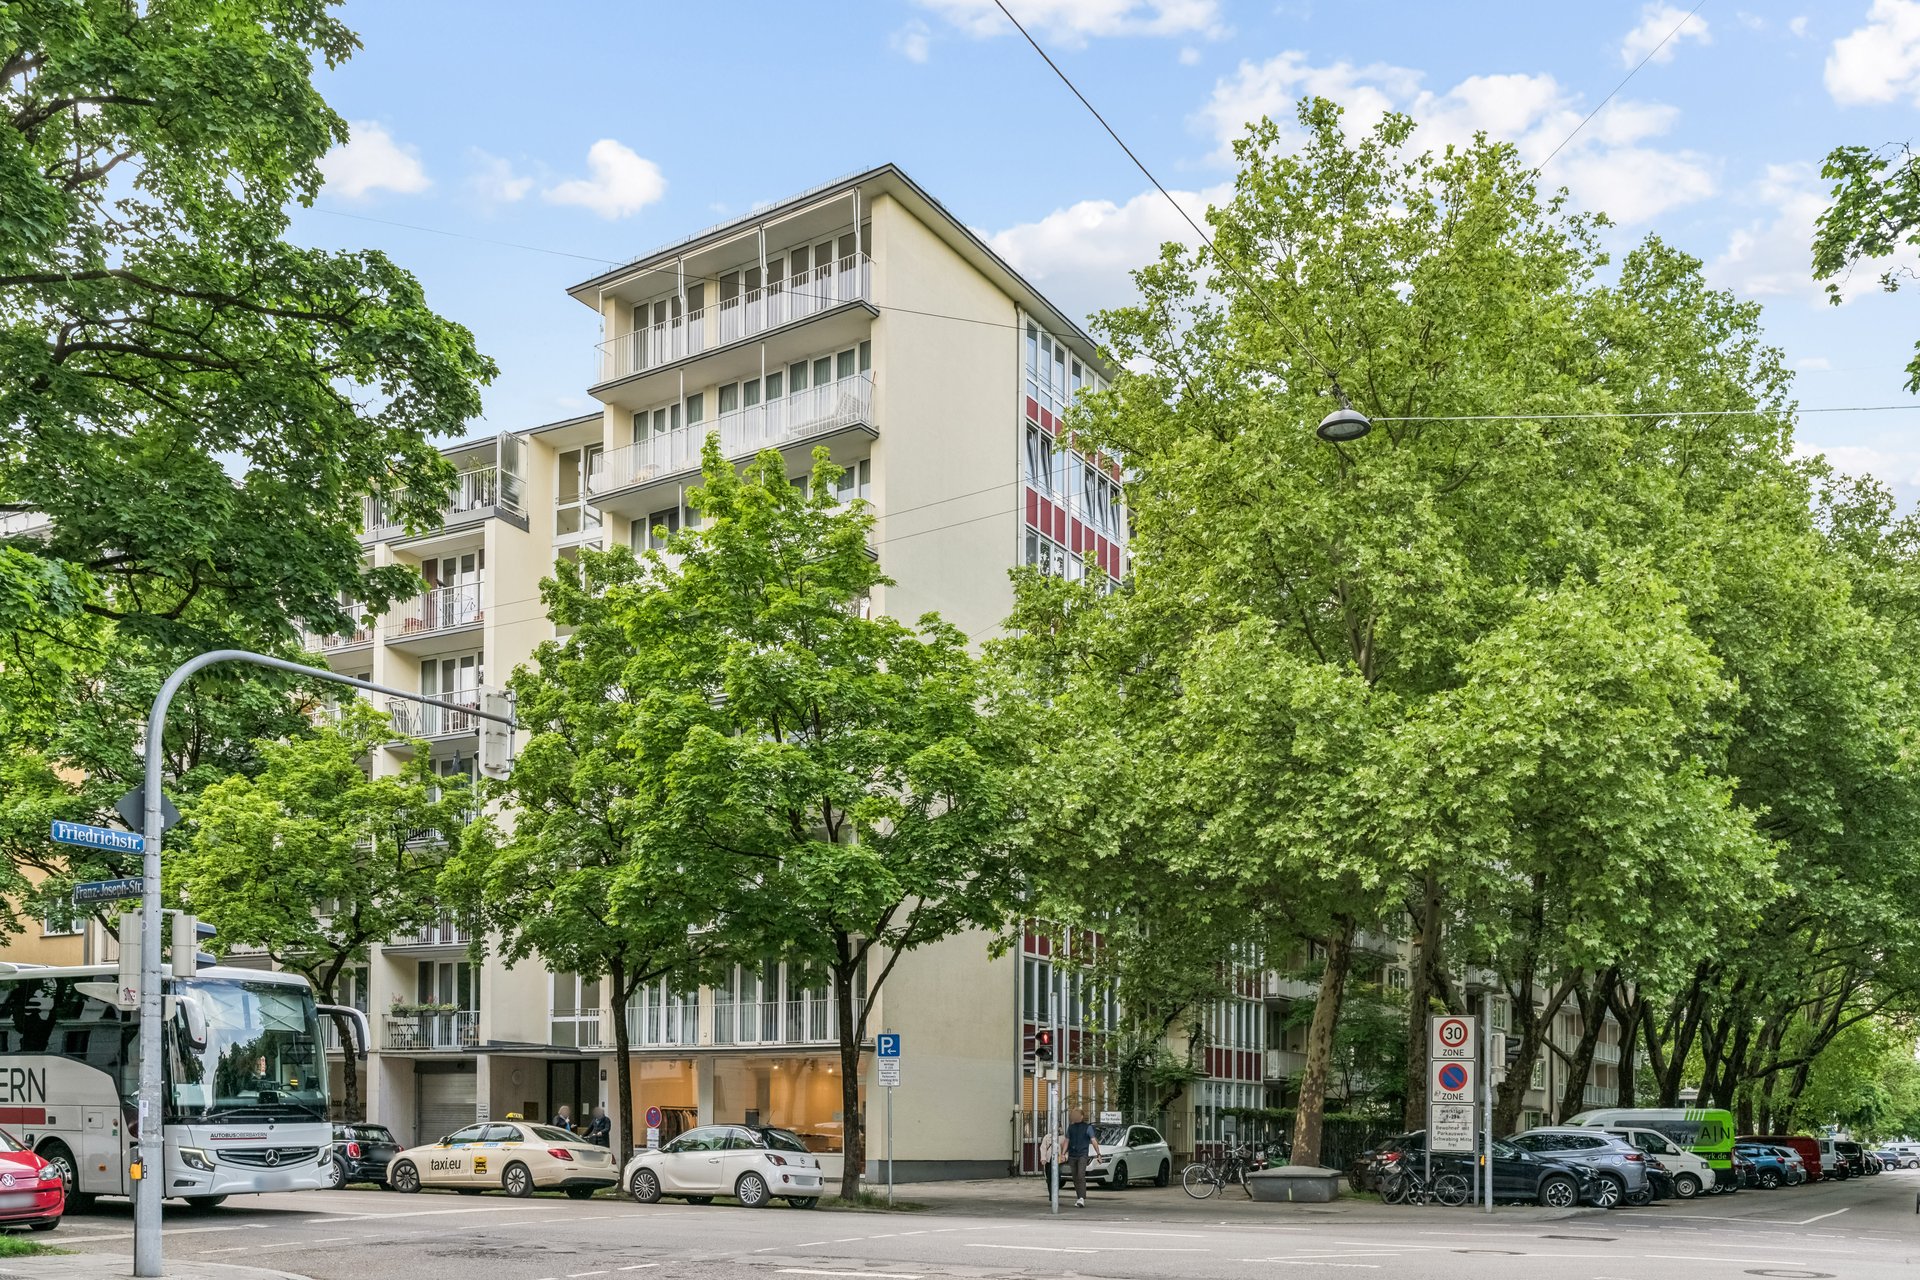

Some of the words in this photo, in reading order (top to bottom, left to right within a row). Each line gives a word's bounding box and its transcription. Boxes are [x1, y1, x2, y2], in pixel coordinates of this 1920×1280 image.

[58, 823, 140, 850] Friedrichstr.
[75, 880, 143, 900] Franz-Joseph-Str.
[1445, 1027, 1462, 1040] 30
[881, 1036, 894, 1055] P
[1442, 1049, 1465, 1057] ZONE
[1442, 1092, 1465, 1101] ZONE
[1701, 1152, 1727, 1160] erk.de
[430, 1157, 461, 1170] taxi.eu
